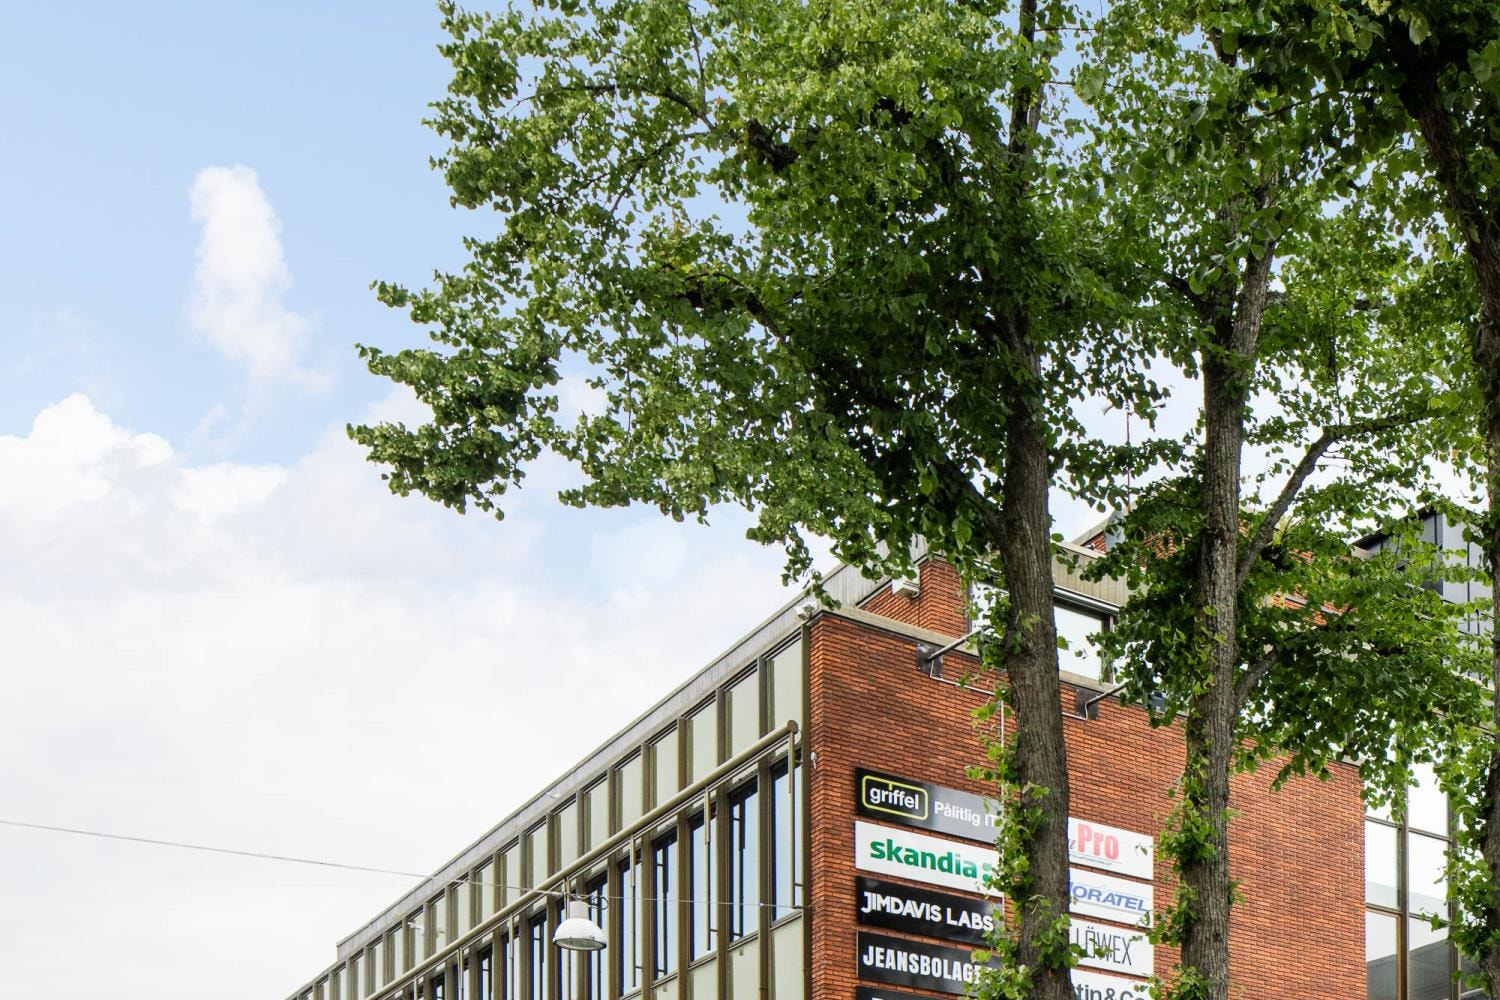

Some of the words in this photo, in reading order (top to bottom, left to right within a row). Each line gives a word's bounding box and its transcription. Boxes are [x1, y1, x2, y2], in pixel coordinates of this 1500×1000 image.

[869, 786, 919, 810] griffel
[934, 801, 980, 827] Pålitlig
[870, 838, 978, 879] skandia
[1077, 823, 1119, 861] Pro
[861, 891, 942, 922] JIMDAVIS
[946, 907, 994, 931] LABS
[862, 945, 995, 984] JEANSBOLAGE
